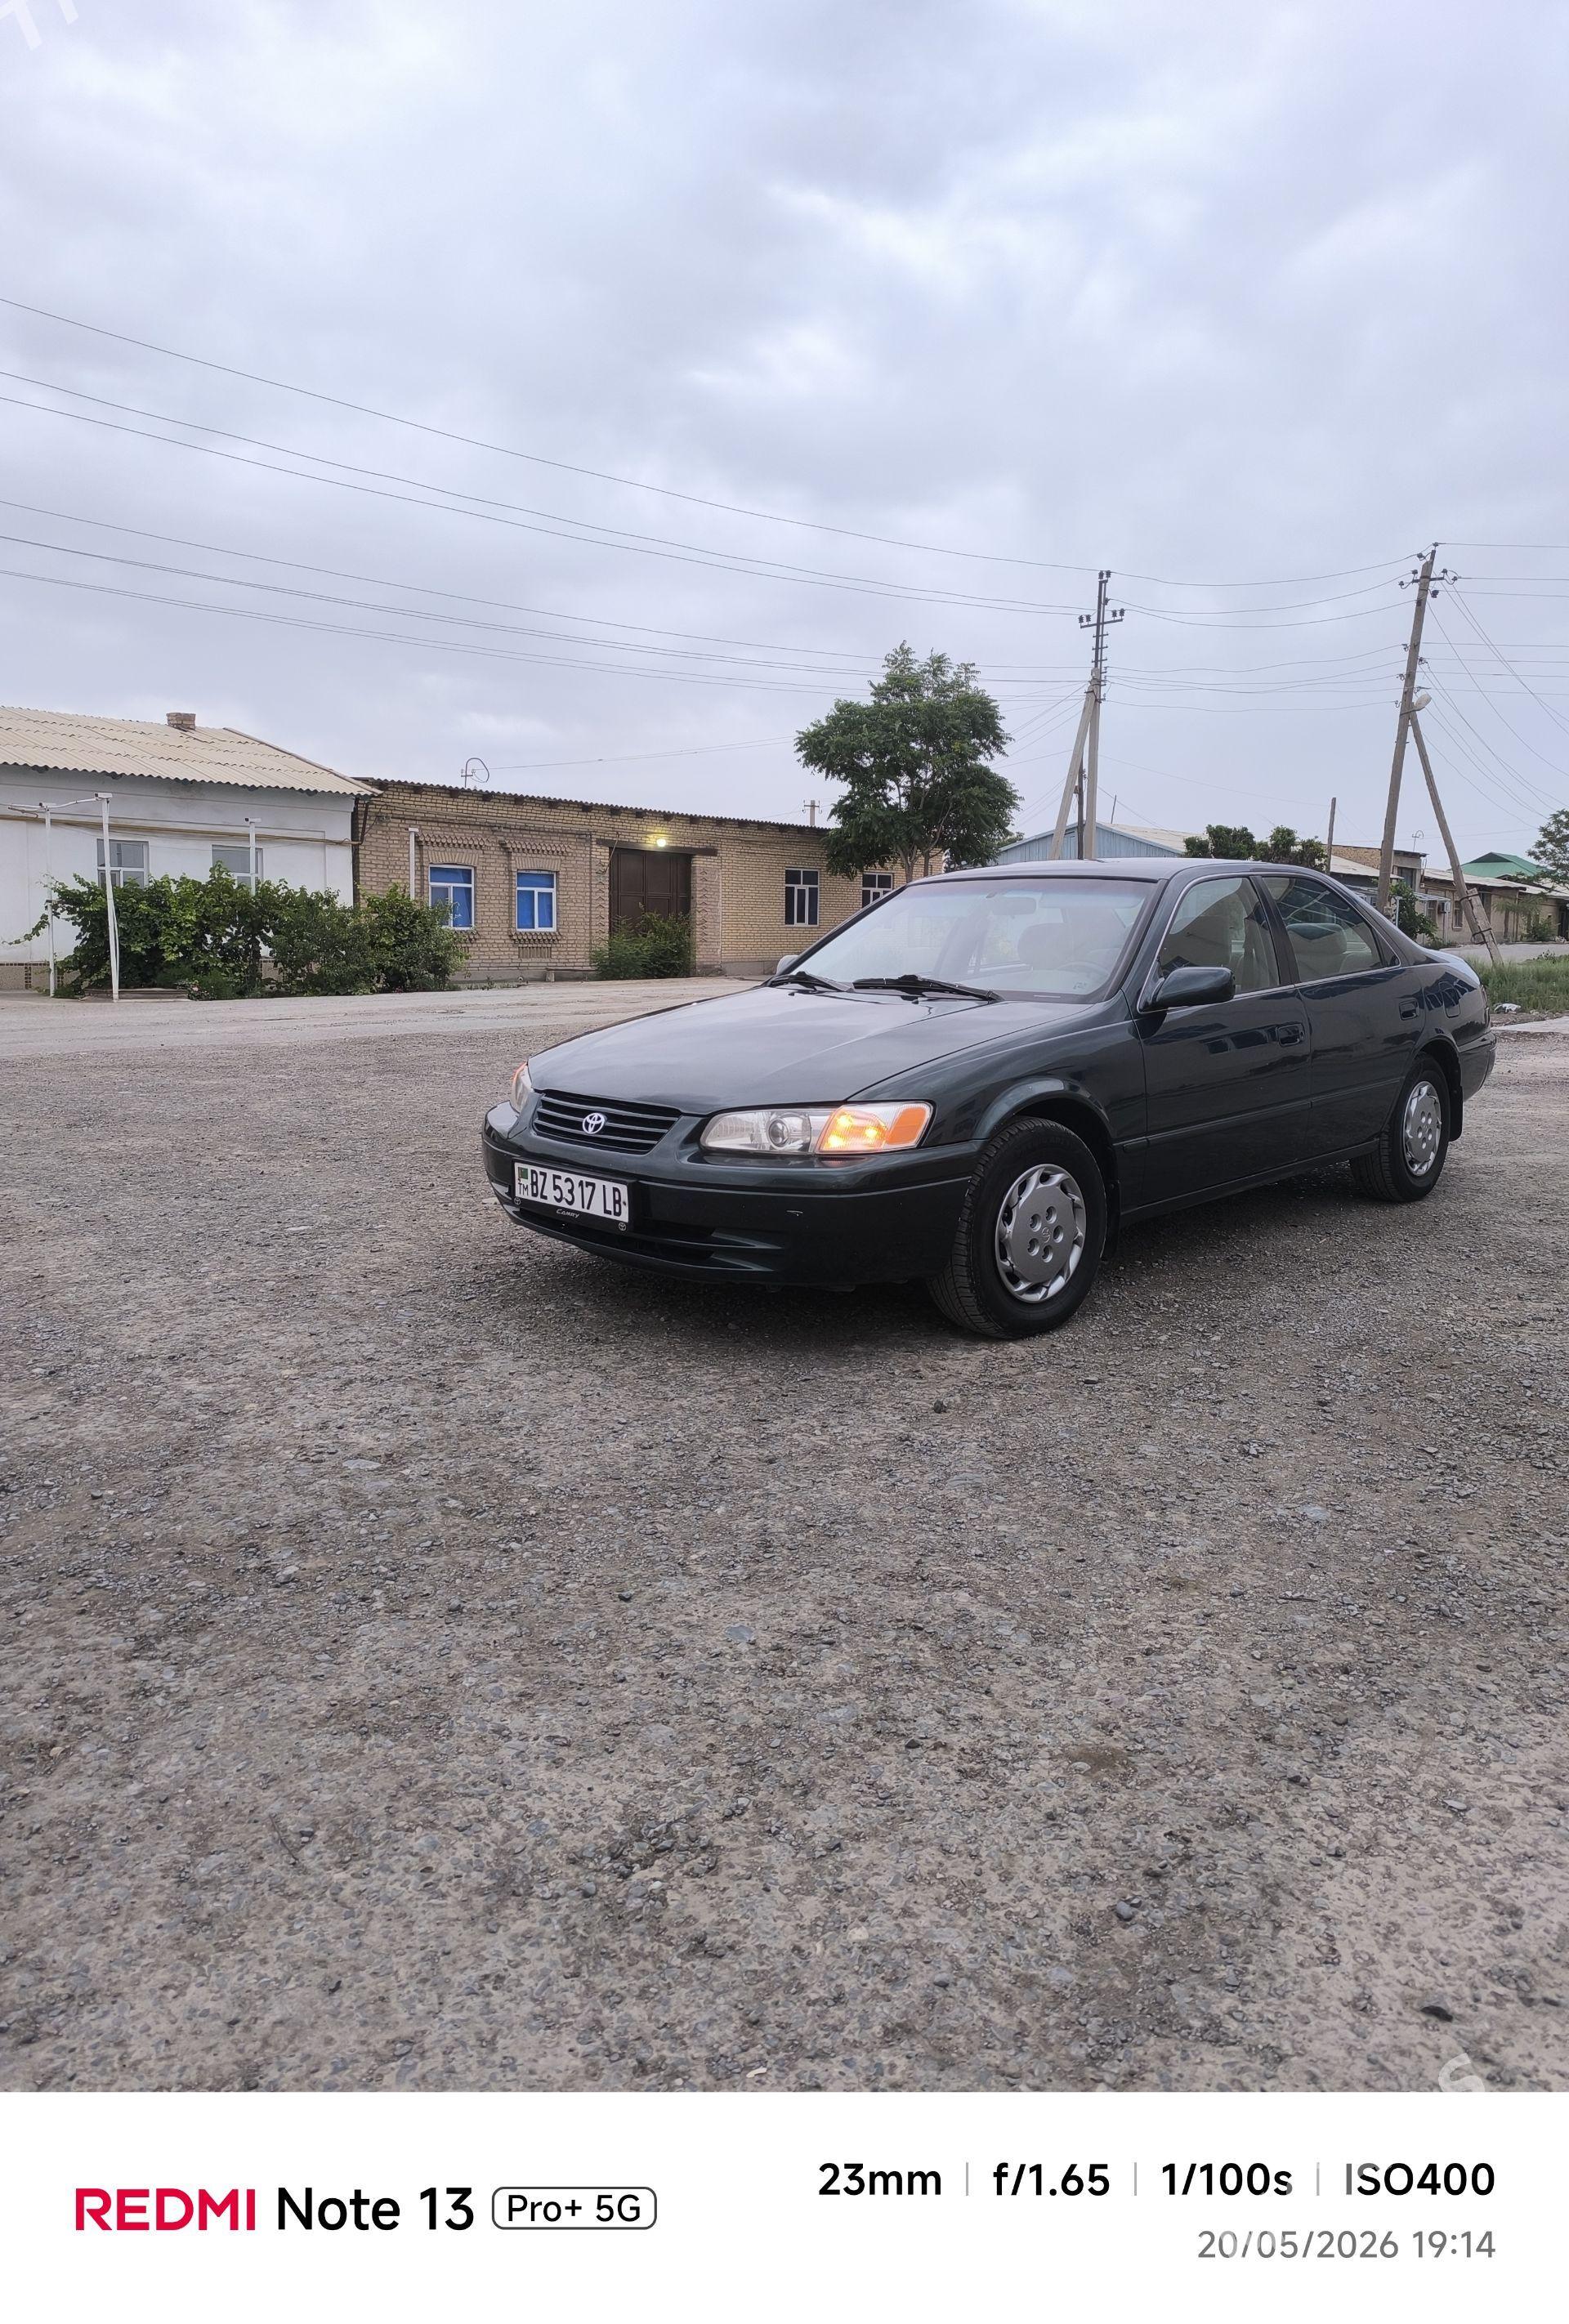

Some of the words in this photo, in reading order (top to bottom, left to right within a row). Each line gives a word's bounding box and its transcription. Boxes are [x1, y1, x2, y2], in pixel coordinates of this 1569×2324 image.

[518, 1182, 529, 1196] TM
[530, 1169, 548, 1200] BZ
[552, 1173, 597, 1211] 5317
[602, 1184, 622, 1218] LB
